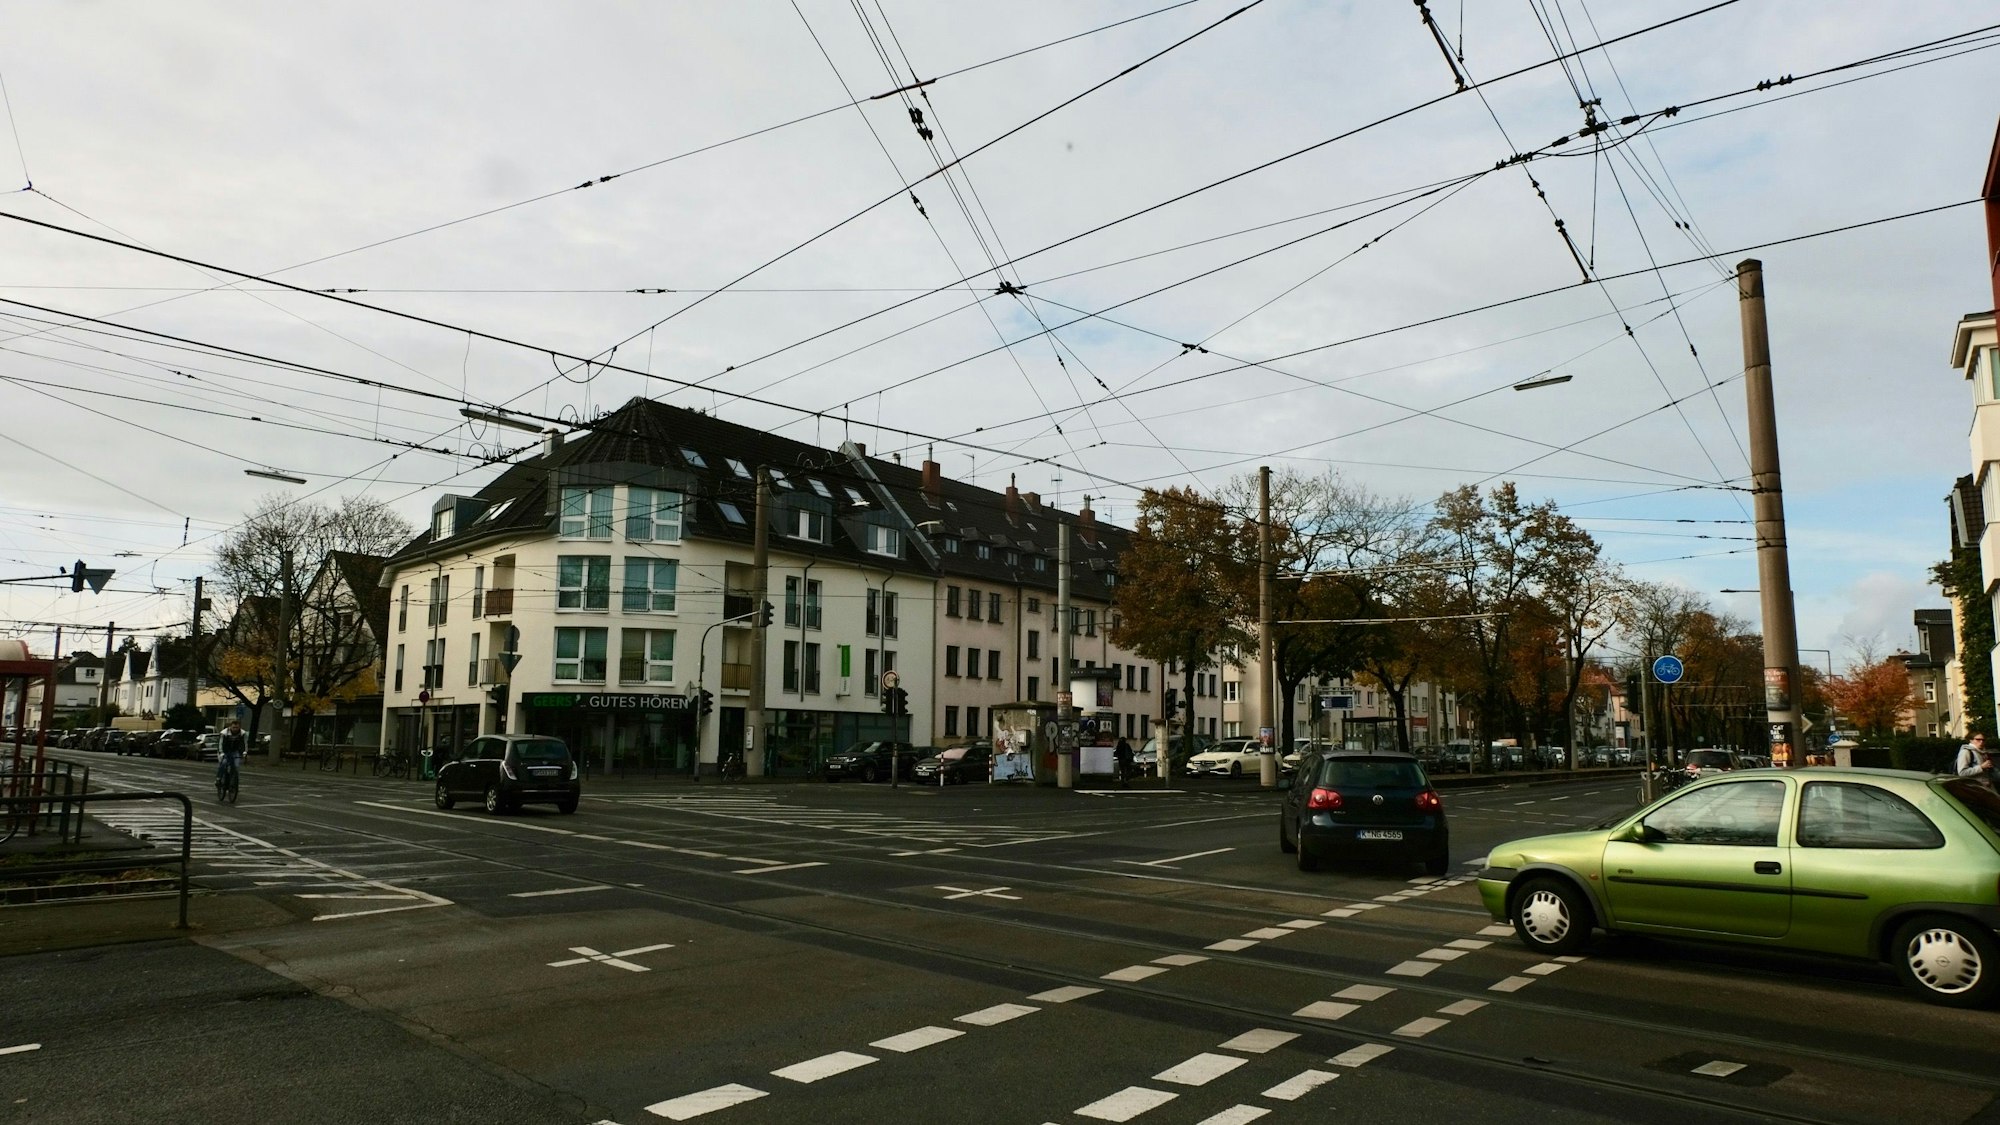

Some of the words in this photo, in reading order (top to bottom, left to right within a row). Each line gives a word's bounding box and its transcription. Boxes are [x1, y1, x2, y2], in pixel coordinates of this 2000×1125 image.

[533, 695, 573, 707] GEERS
[589, 695, 636, 708] GUTES
[640, 693, 689, 709] HÖREN
